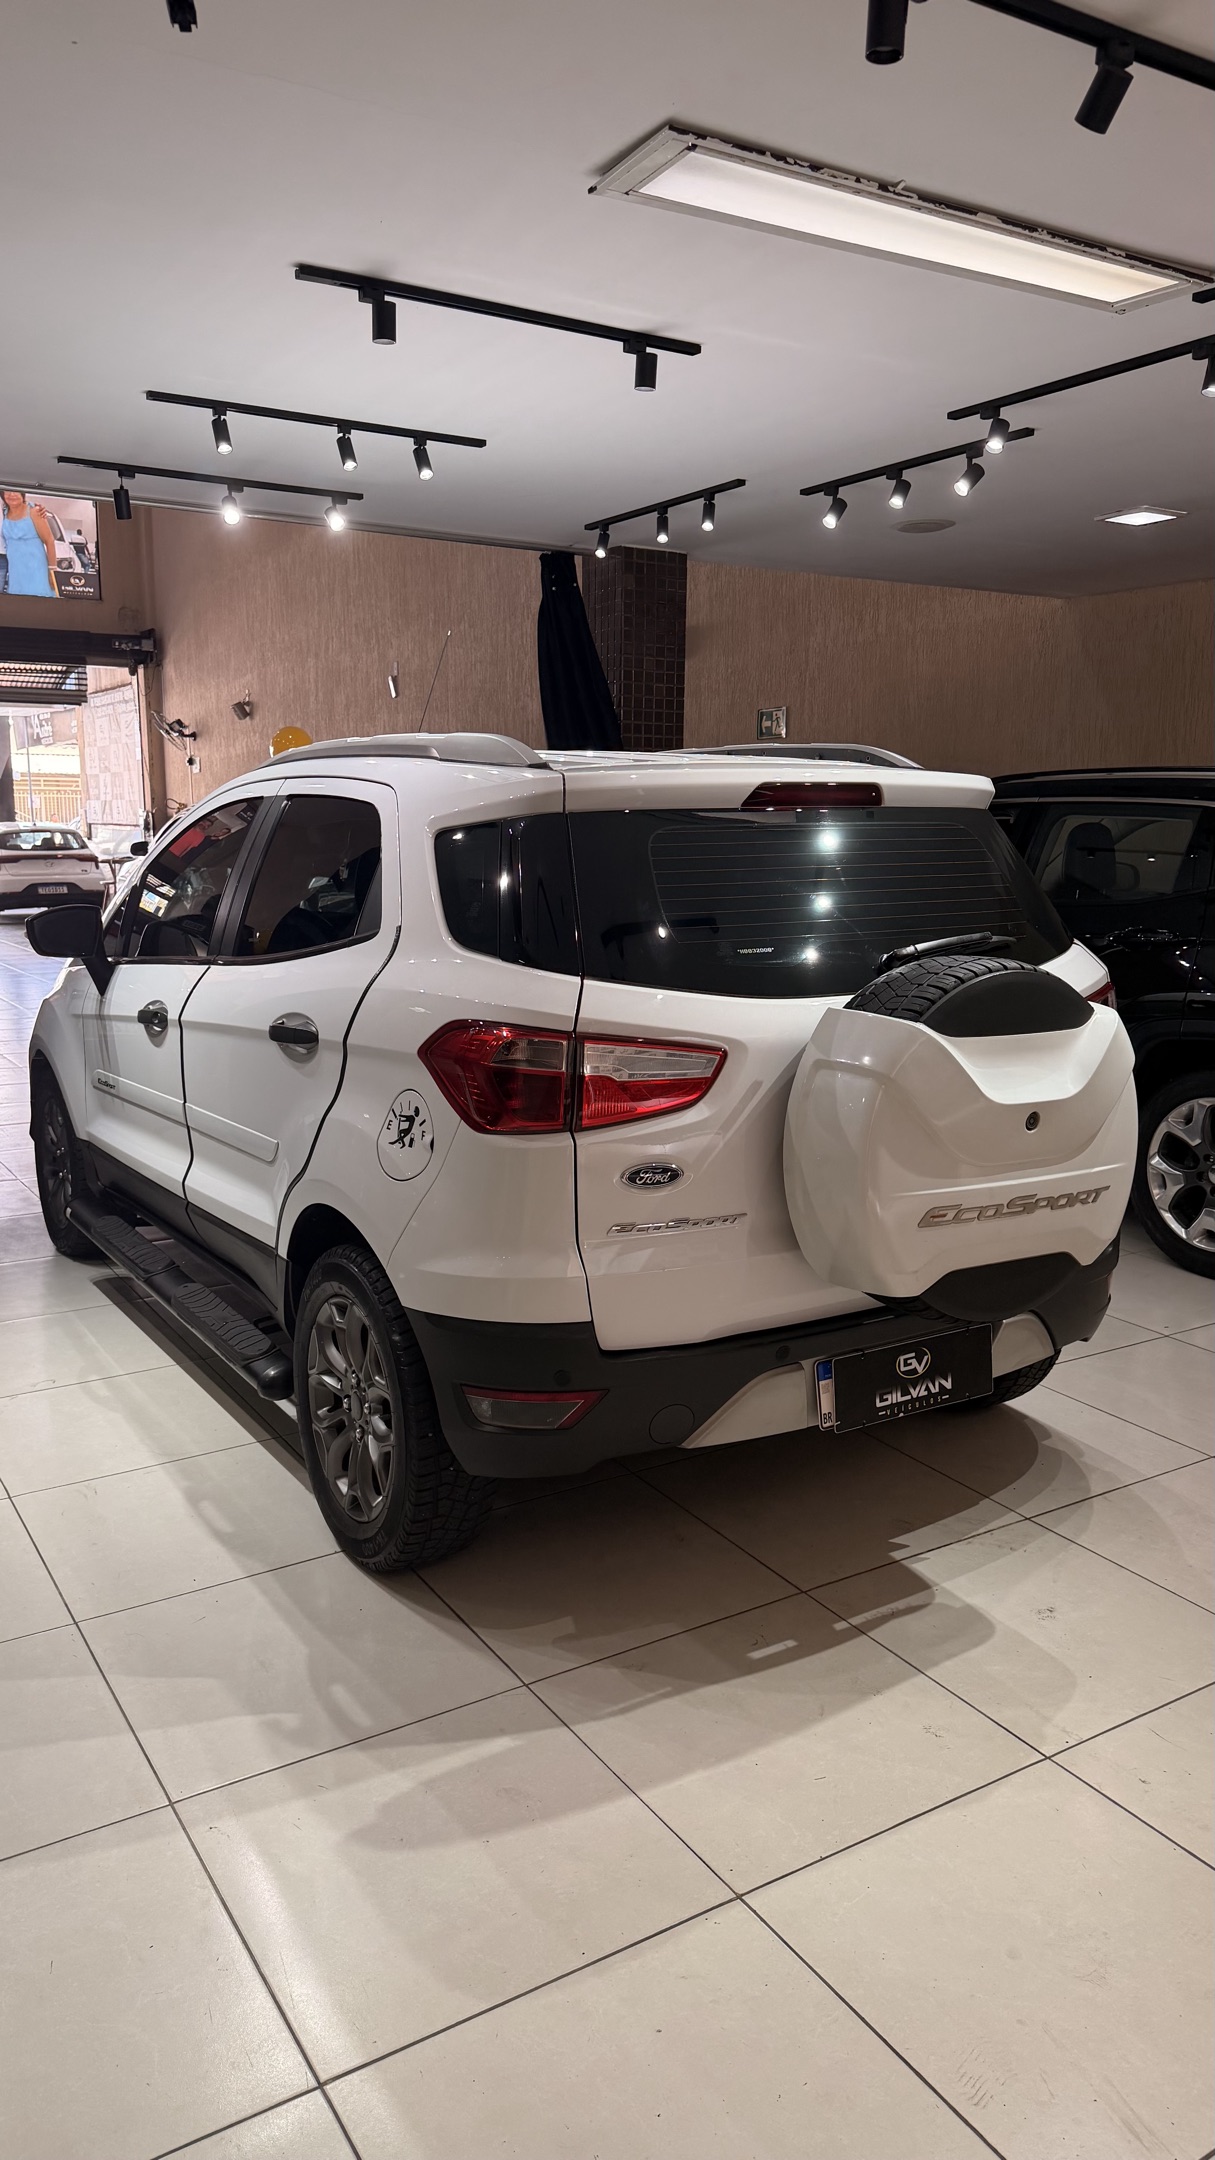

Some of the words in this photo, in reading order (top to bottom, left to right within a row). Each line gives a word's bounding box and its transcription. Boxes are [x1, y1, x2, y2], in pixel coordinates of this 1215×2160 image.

[386, 1119, 394, 1131] E
[420, 1130, 427, 1141] F
[635, 1168, 672, 1185] Ford
[875, 1371, 953, 1408] GILVAN
[886, 1395, 942, 1416] VEÍCULOS
[822, 1411, 833, 1425] BR
